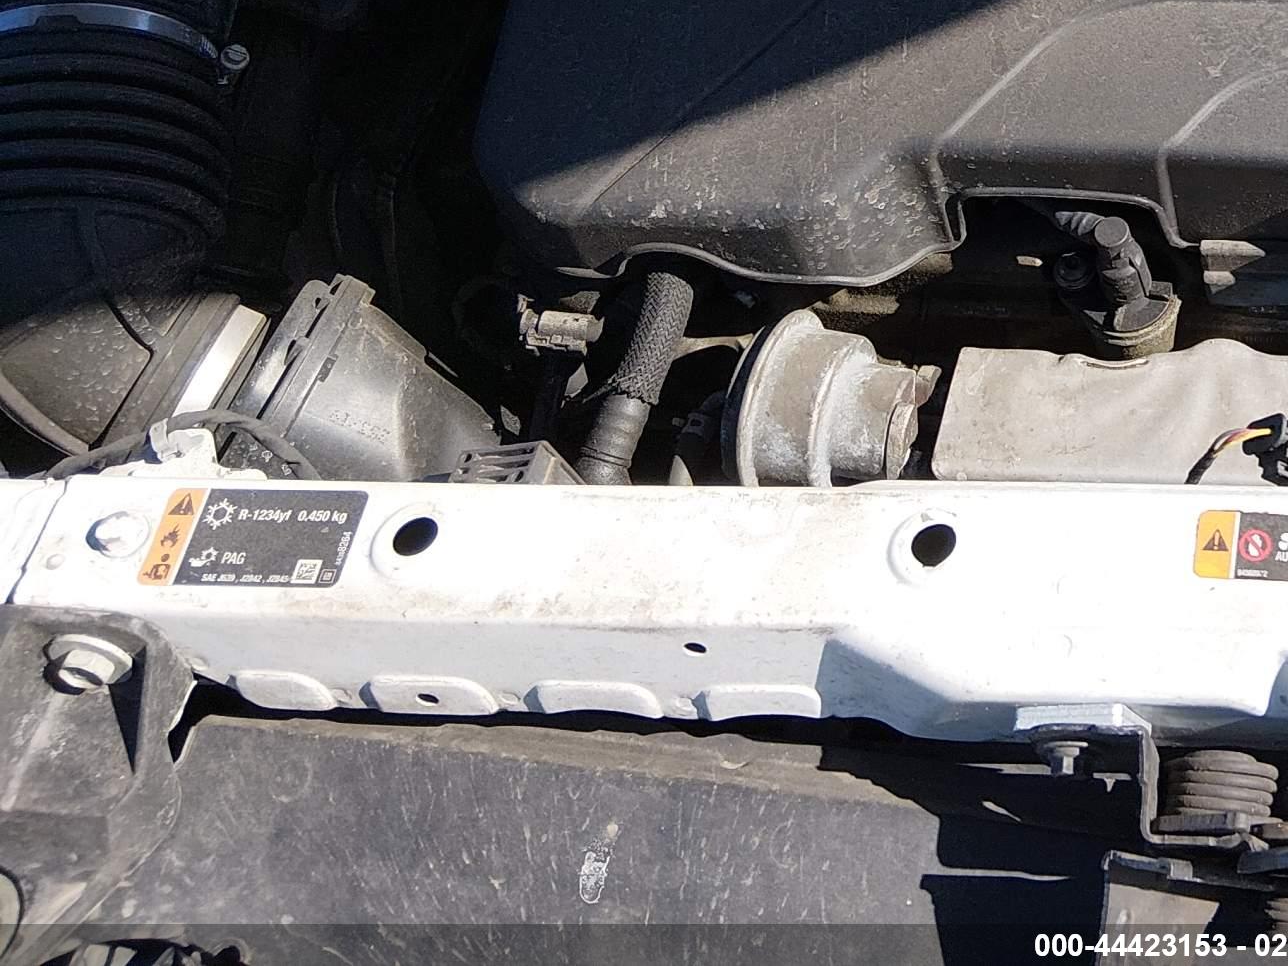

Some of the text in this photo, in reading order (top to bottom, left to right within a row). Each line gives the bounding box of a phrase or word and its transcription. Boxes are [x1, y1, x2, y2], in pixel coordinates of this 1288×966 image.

[238, 509, 348, 524] R-1234yf 0.450 kg
[220, 552, 246, 565] PAG
